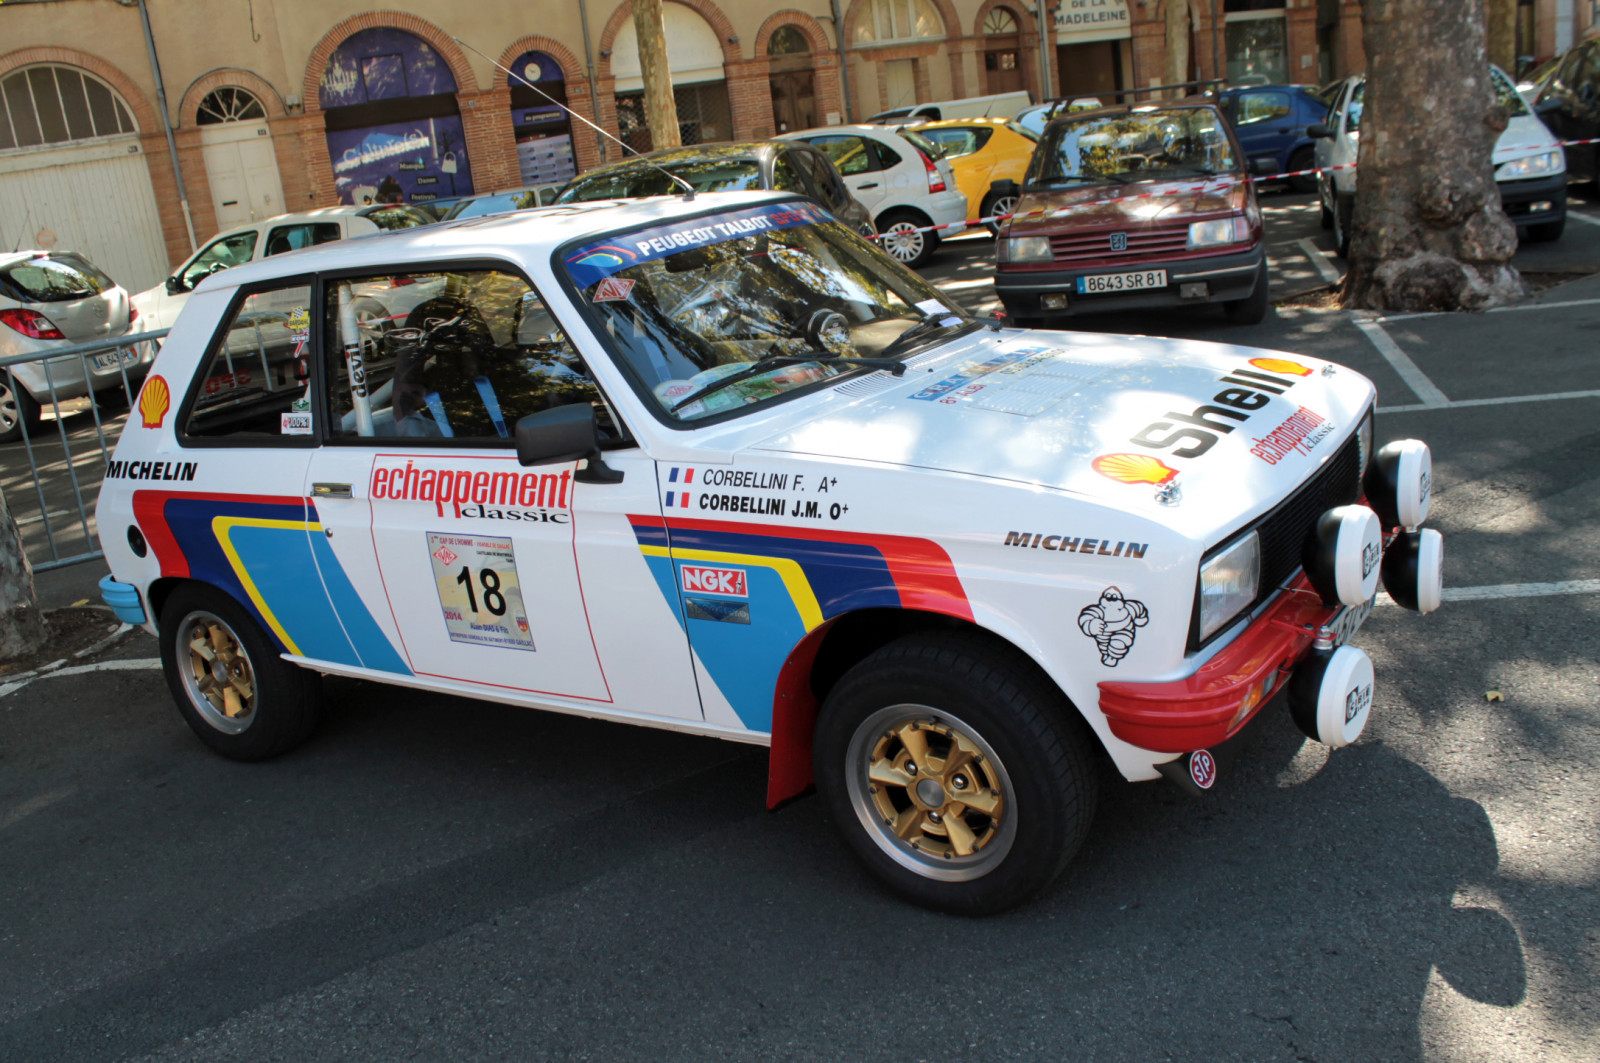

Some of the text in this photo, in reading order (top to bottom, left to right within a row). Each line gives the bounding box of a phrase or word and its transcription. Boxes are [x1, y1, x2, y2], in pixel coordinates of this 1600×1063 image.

[1072, 0, 1086, 8] DE
[1054, 10, 1127, 25] MADELEINE
[635, 229, 713, 256] PEUGEOT
[714, 215, 773, 237] TALBOT
[1088, 271, 1163, 291] 8643 SR 81
[344, 343, 369, 398] devil
[1129, 368, 1296, 459] Shell
[1250, 405, 1326, 466] echappement
[1306, 422, 1336, 449] classic
[106, 460, 198, 481] MICHELIN
[703, 468, 788, 490] CORBELLINI
[793, 474, 805, 491] F.
[372, 460, 571, 519] echappement
[461, 504, 570, 524] classic
[699, 493, 786, 516] CORBELLINI
[791, 500, 822, 519] J.M.
[1004, 531, 1149, 559] MICHELIN
[456, 565, 507, 616] 18
[684, 568, 735, 593] NGK
[444, 611, 462, 620] 2014
[1193, 753, 1211, 783] STP
